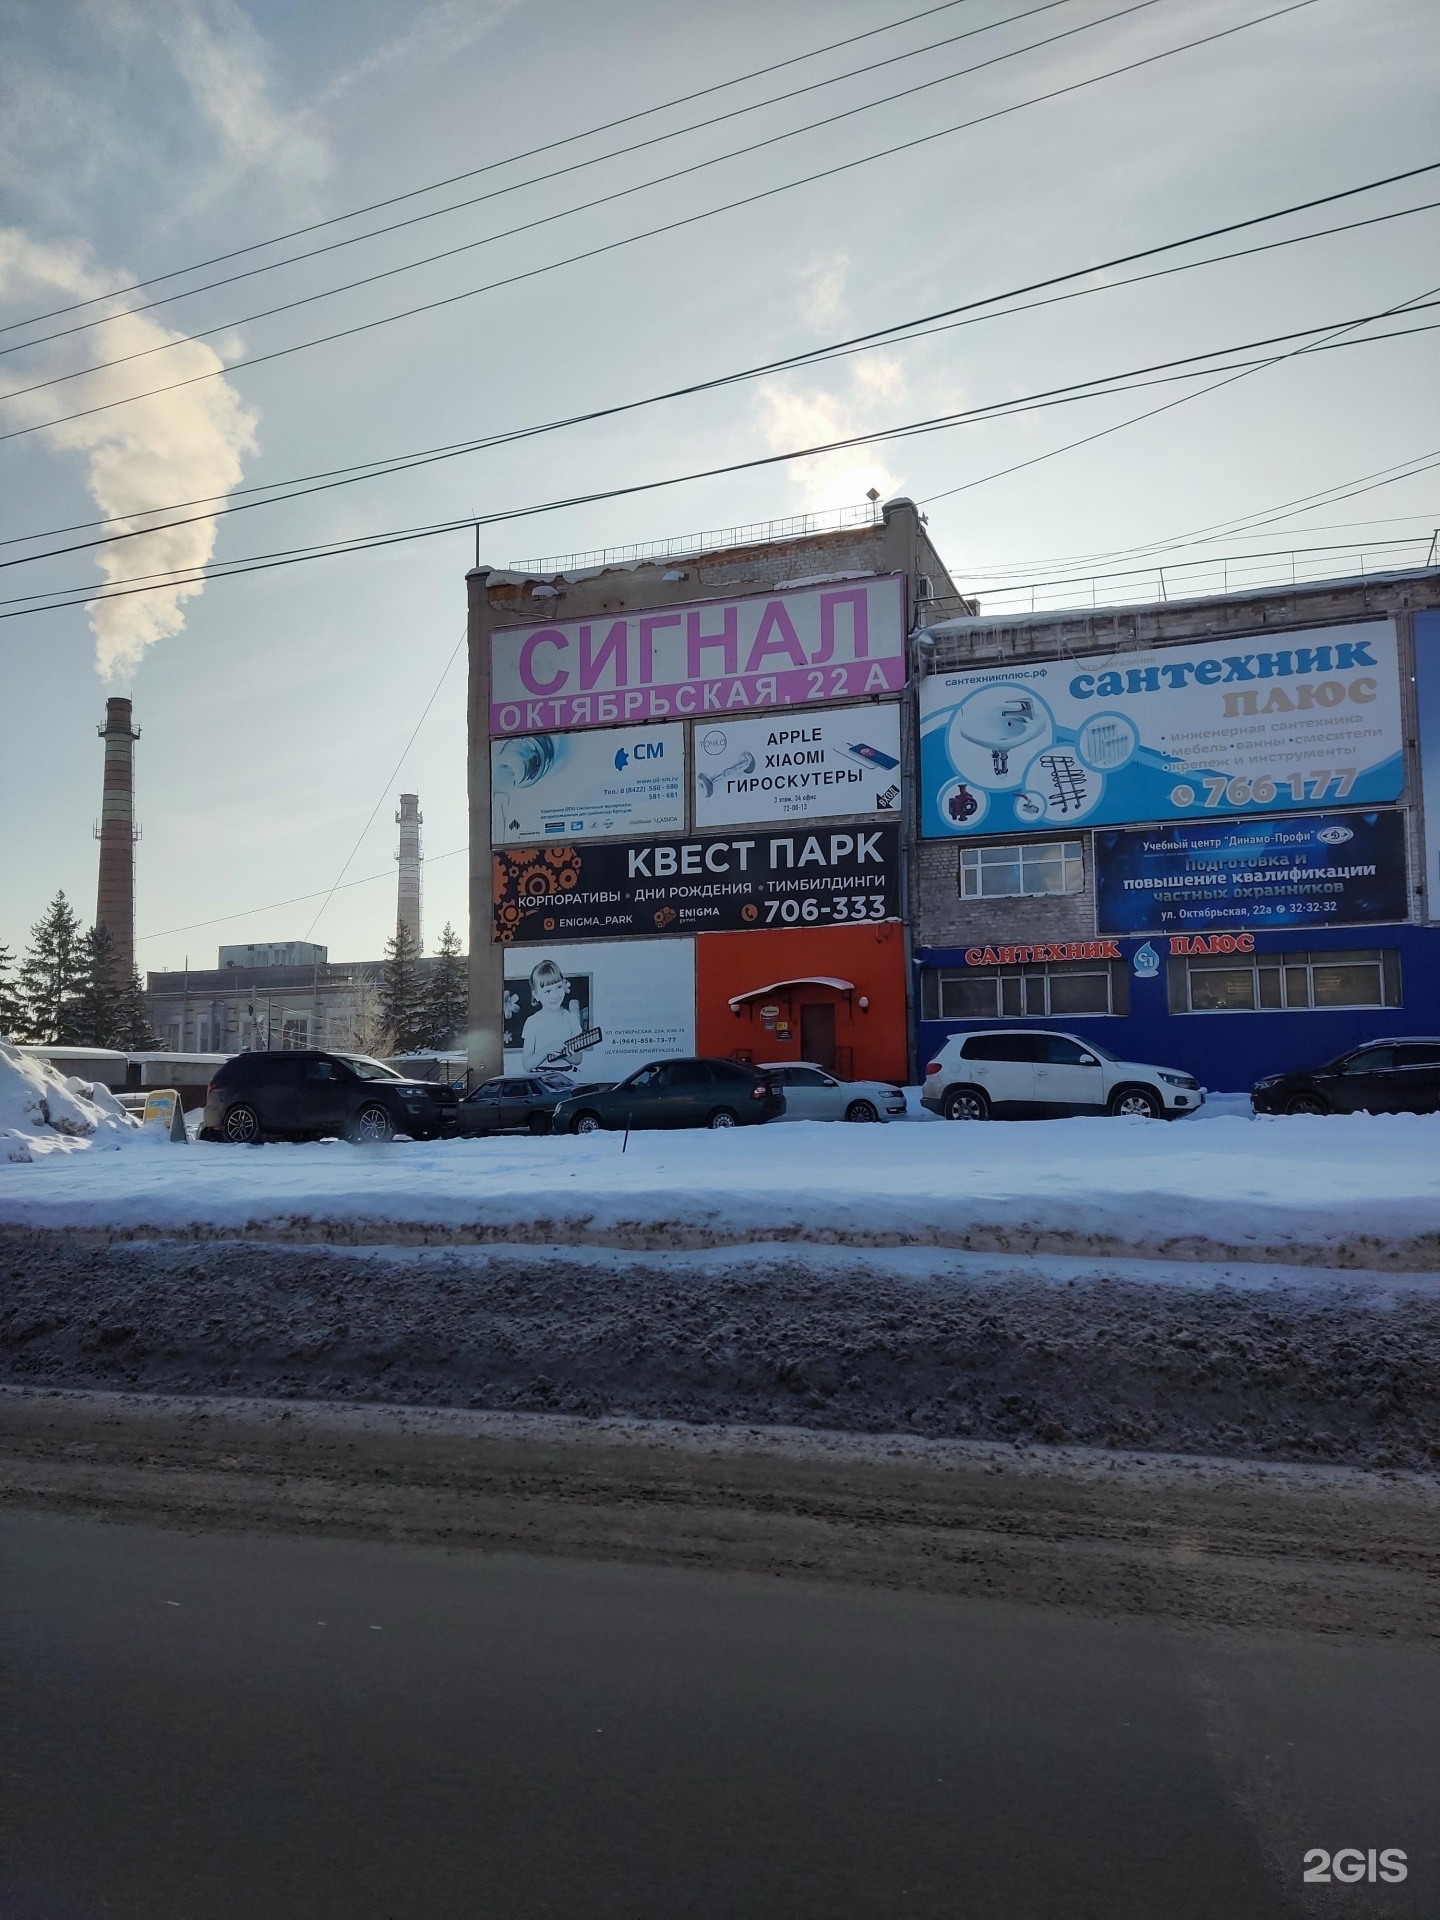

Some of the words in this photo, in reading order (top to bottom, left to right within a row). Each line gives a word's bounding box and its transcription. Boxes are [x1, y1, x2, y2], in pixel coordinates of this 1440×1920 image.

[518, 588, 869, 696] СИГНАЛ
[1069, 641, 1378, 699] сантехник
[1101, 655, 1156, 669] магазинов
[945, 669, 1048, 686] сантехникплюс.рф
[499, 677, 791, 731] ОКТЯБРЬСКАЯ,
[806, 668, 849, 699] 22
[864, 663, 890, 692] А
[767, 728, 822, 746] APPLE
[1170, 724, 1266, 742] инженерная
[1271, 715, 1363, 732] сантехника
[1171, 741, 1227, 757] мебель
[1236, 737, 1285, 750] ванны
[1295, 728, 1383, 744] смесители
[764, 750, 825, 769] XIAOMI
[1172, 758, 1229, 773] крепеж
[1234, 755, 1244, 765] и
[1249, 746, 1357, 764] инструменты
[727, 769, 863, 794] ГИРОСКУТЕРЫ
[1203, 774, 1276, 807] 766
[1287, 767, 1357, 801] 177
[878, 785, 899, 808] ВХОД
[628, 841, 755, 878] КВЕСТ
[770, 831, 884, 869] ПАРК
[1143, 839, 1188, 852] Учебный
[1191, 837, 1221, 850] центр
[1185, 854, 1290, 873] Подготовка
[1295, 854, 1307, 865] и
[1124, 873, 1227, 890] повышение
[1232, 864, 1376, 885] квалификации
[518, 890, 622, 909] КОРПОРАТИВЫ
[634, 886, 666, 903] ДНИ
[669, 882, 753, 900] РОЖДЕНИЯ
[767, 875, 886, 894] ТИМБИЛДИНГИ
[1153, 888, 1229, 903] частных
[1233, 881, 1345, 900] охранников
[559, 915, 633, 928] ENIGMA_PARK
[679, 907, 720, 918] ENIGMA
[764, 895, 887, 923] 706-333
[1161, 910, 1177, 921] ул.
[1179, 905, 1250, 919] Октябрьская,
[1253, 904, 1272, 915] 22а
[1289, 901, 1337, 913] 32-32-32
[964, 940, 1122, 966] САНТЕХНИК
[1169, 933, 1255, 955] ПЛЮС
